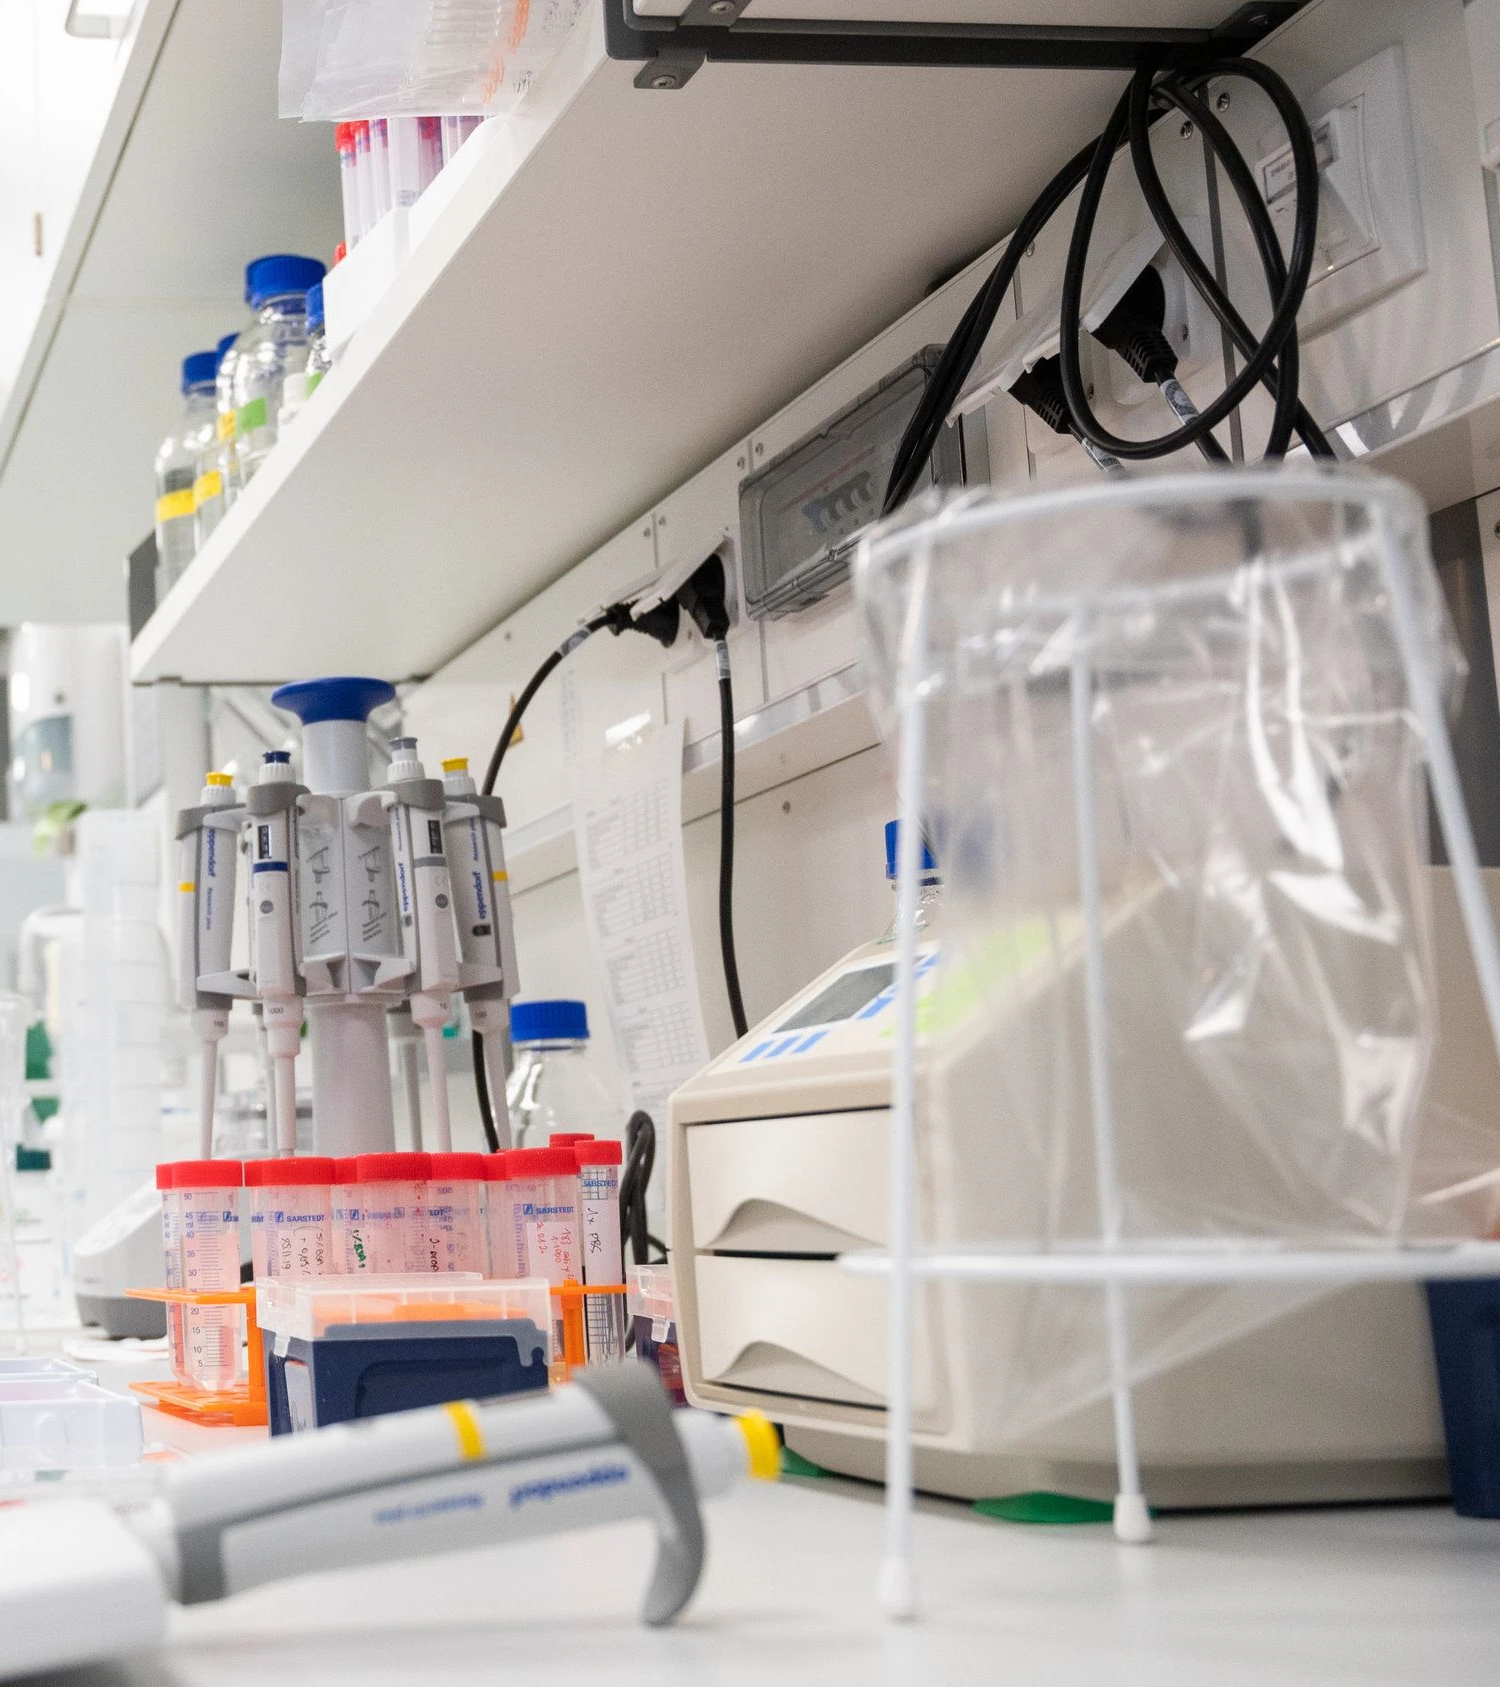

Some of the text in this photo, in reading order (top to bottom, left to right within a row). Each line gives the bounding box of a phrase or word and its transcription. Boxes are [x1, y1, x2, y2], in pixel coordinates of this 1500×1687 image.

[397, 862, 409, 912] eppendorf
[471, 871, 486, 919] eppendorf
[583, 1179, 618, 1188] SARSTED
[183, 1193, 193, 1201] 50
[536, 1206, 574, 1214] SARSTEDT
[286, 1214, 324, 1222] SARSTEDT
[186, 1231, 195, 1239] 40
[186, 1250, 196, 1258] 35
[188, 1269, 197, 1277] 30
[190, 1307, 200, 1315] 20
[192, 1327, 200, 1335] 15
[193, 1346, 202, 1354] 10
[197, 1360, 203, 1368] 5
